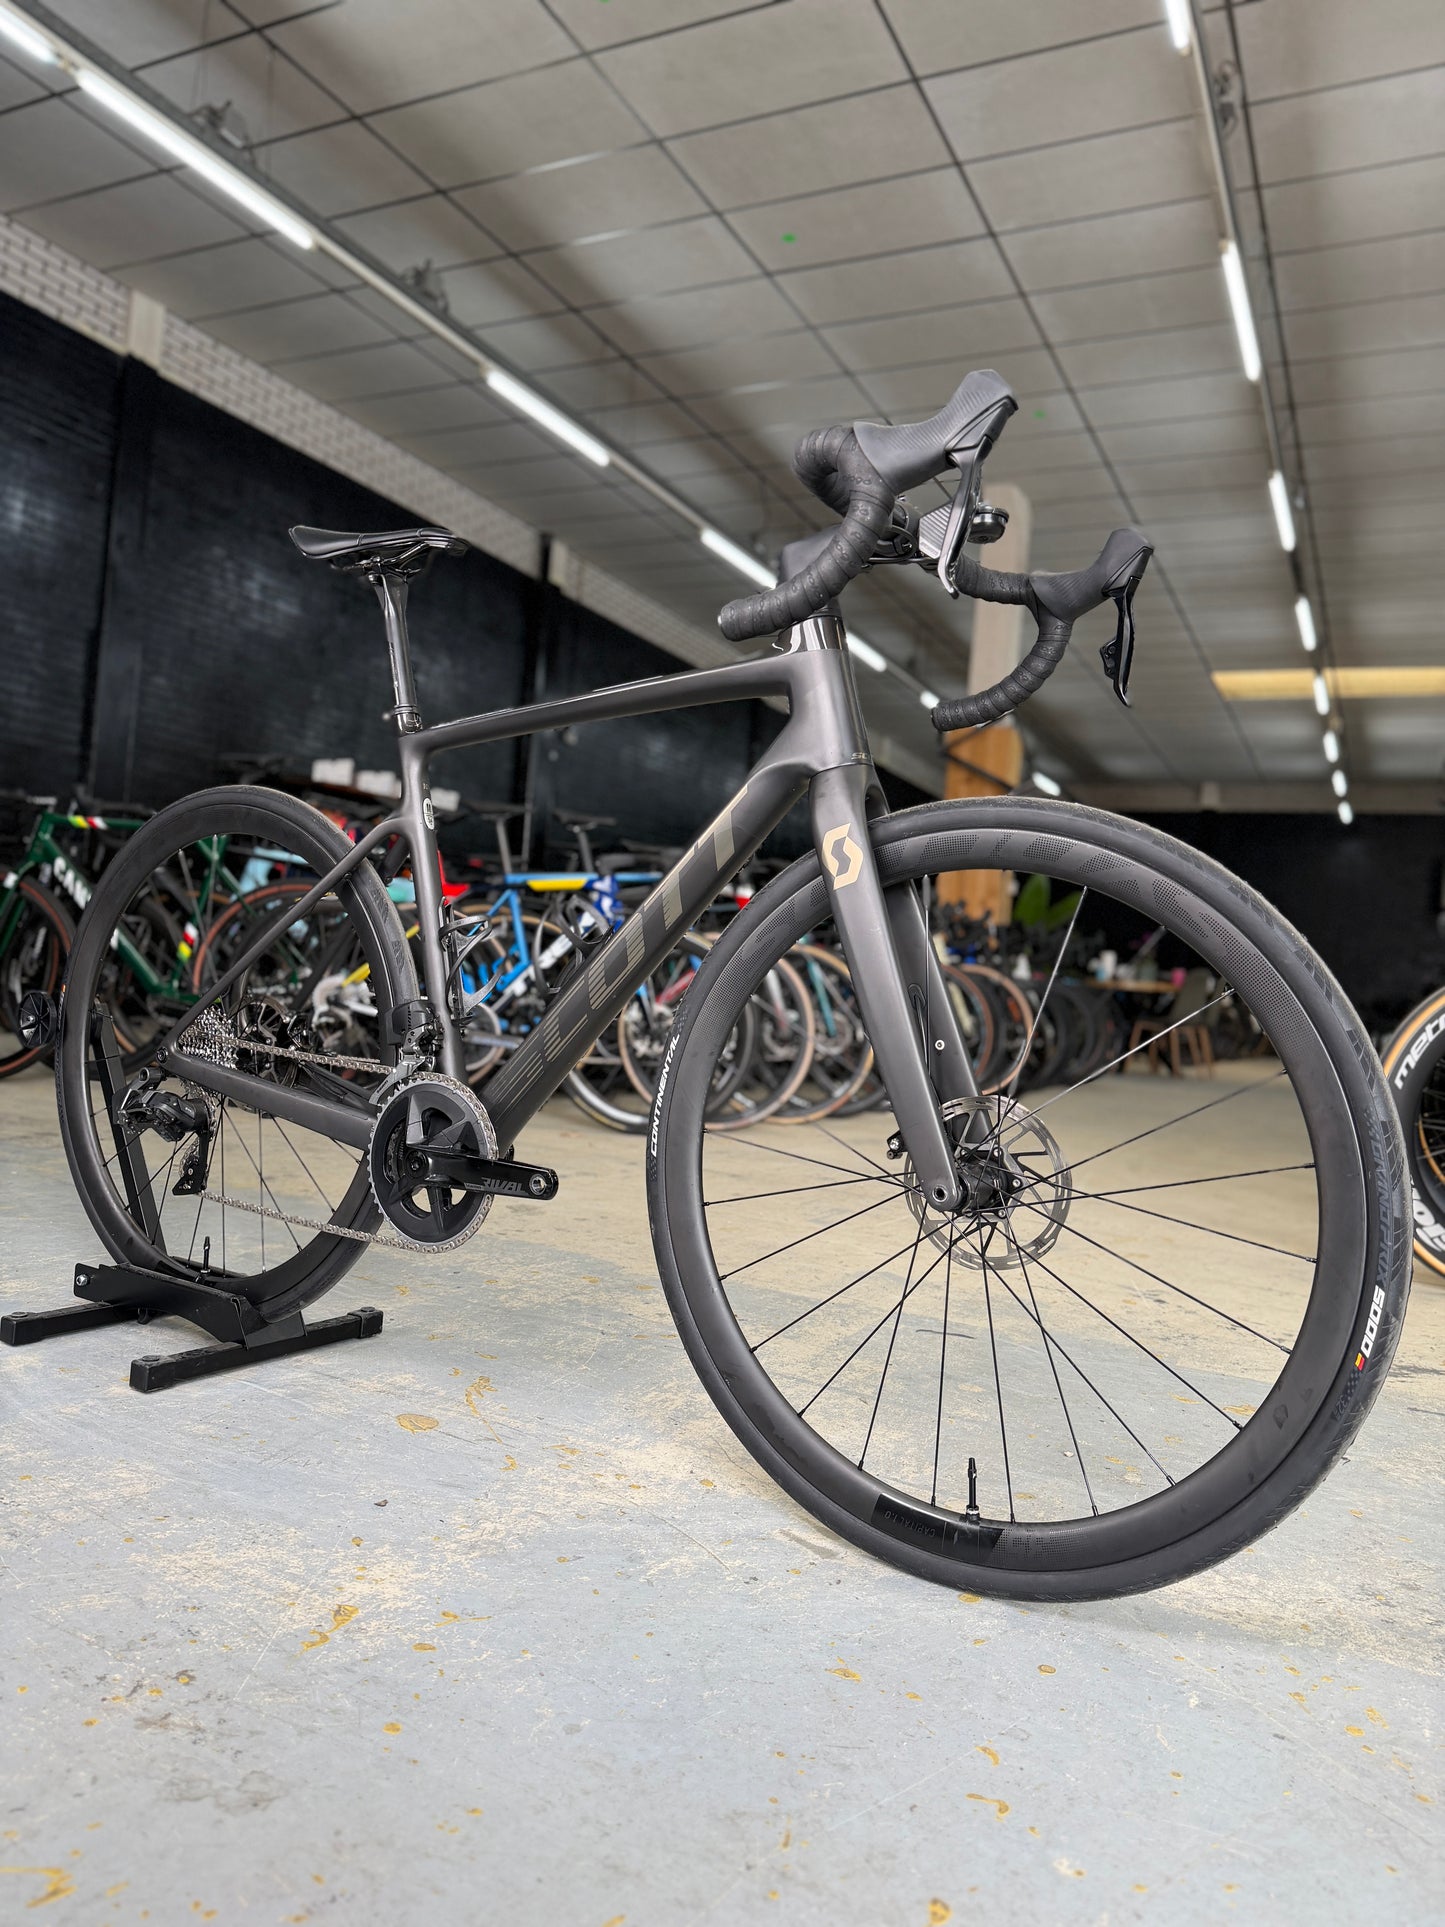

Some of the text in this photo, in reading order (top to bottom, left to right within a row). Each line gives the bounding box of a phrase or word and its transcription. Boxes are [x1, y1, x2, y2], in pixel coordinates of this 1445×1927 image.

[484, 783, 748, 1118] SCOTT
[650, 1034, 680, 1157] CONTINENTAL
[481, 1177, 527, 1193] RIVAL
[1361, 1285, 1385, 1358] 5000
[884, 1510, 937, 1537] CAPITAL 1.0
